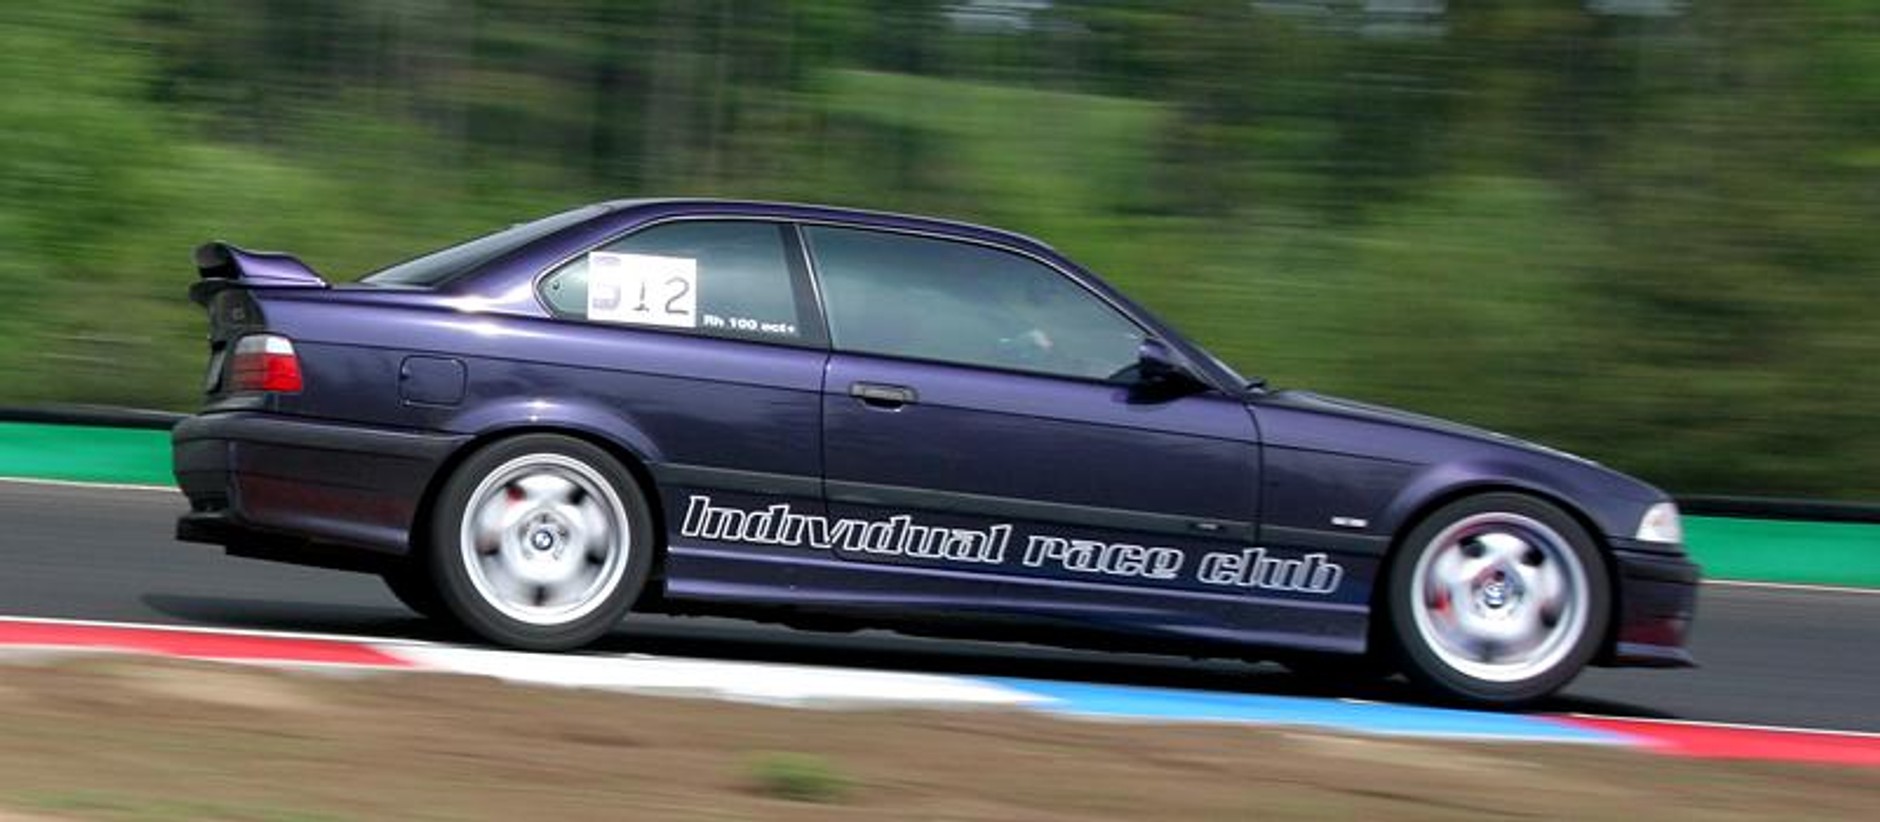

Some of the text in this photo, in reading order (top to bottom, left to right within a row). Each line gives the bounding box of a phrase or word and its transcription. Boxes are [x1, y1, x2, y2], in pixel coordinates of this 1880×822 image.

[729, 318, 758, 331] 100
[682, 496, 1344, 594] Individual race club
